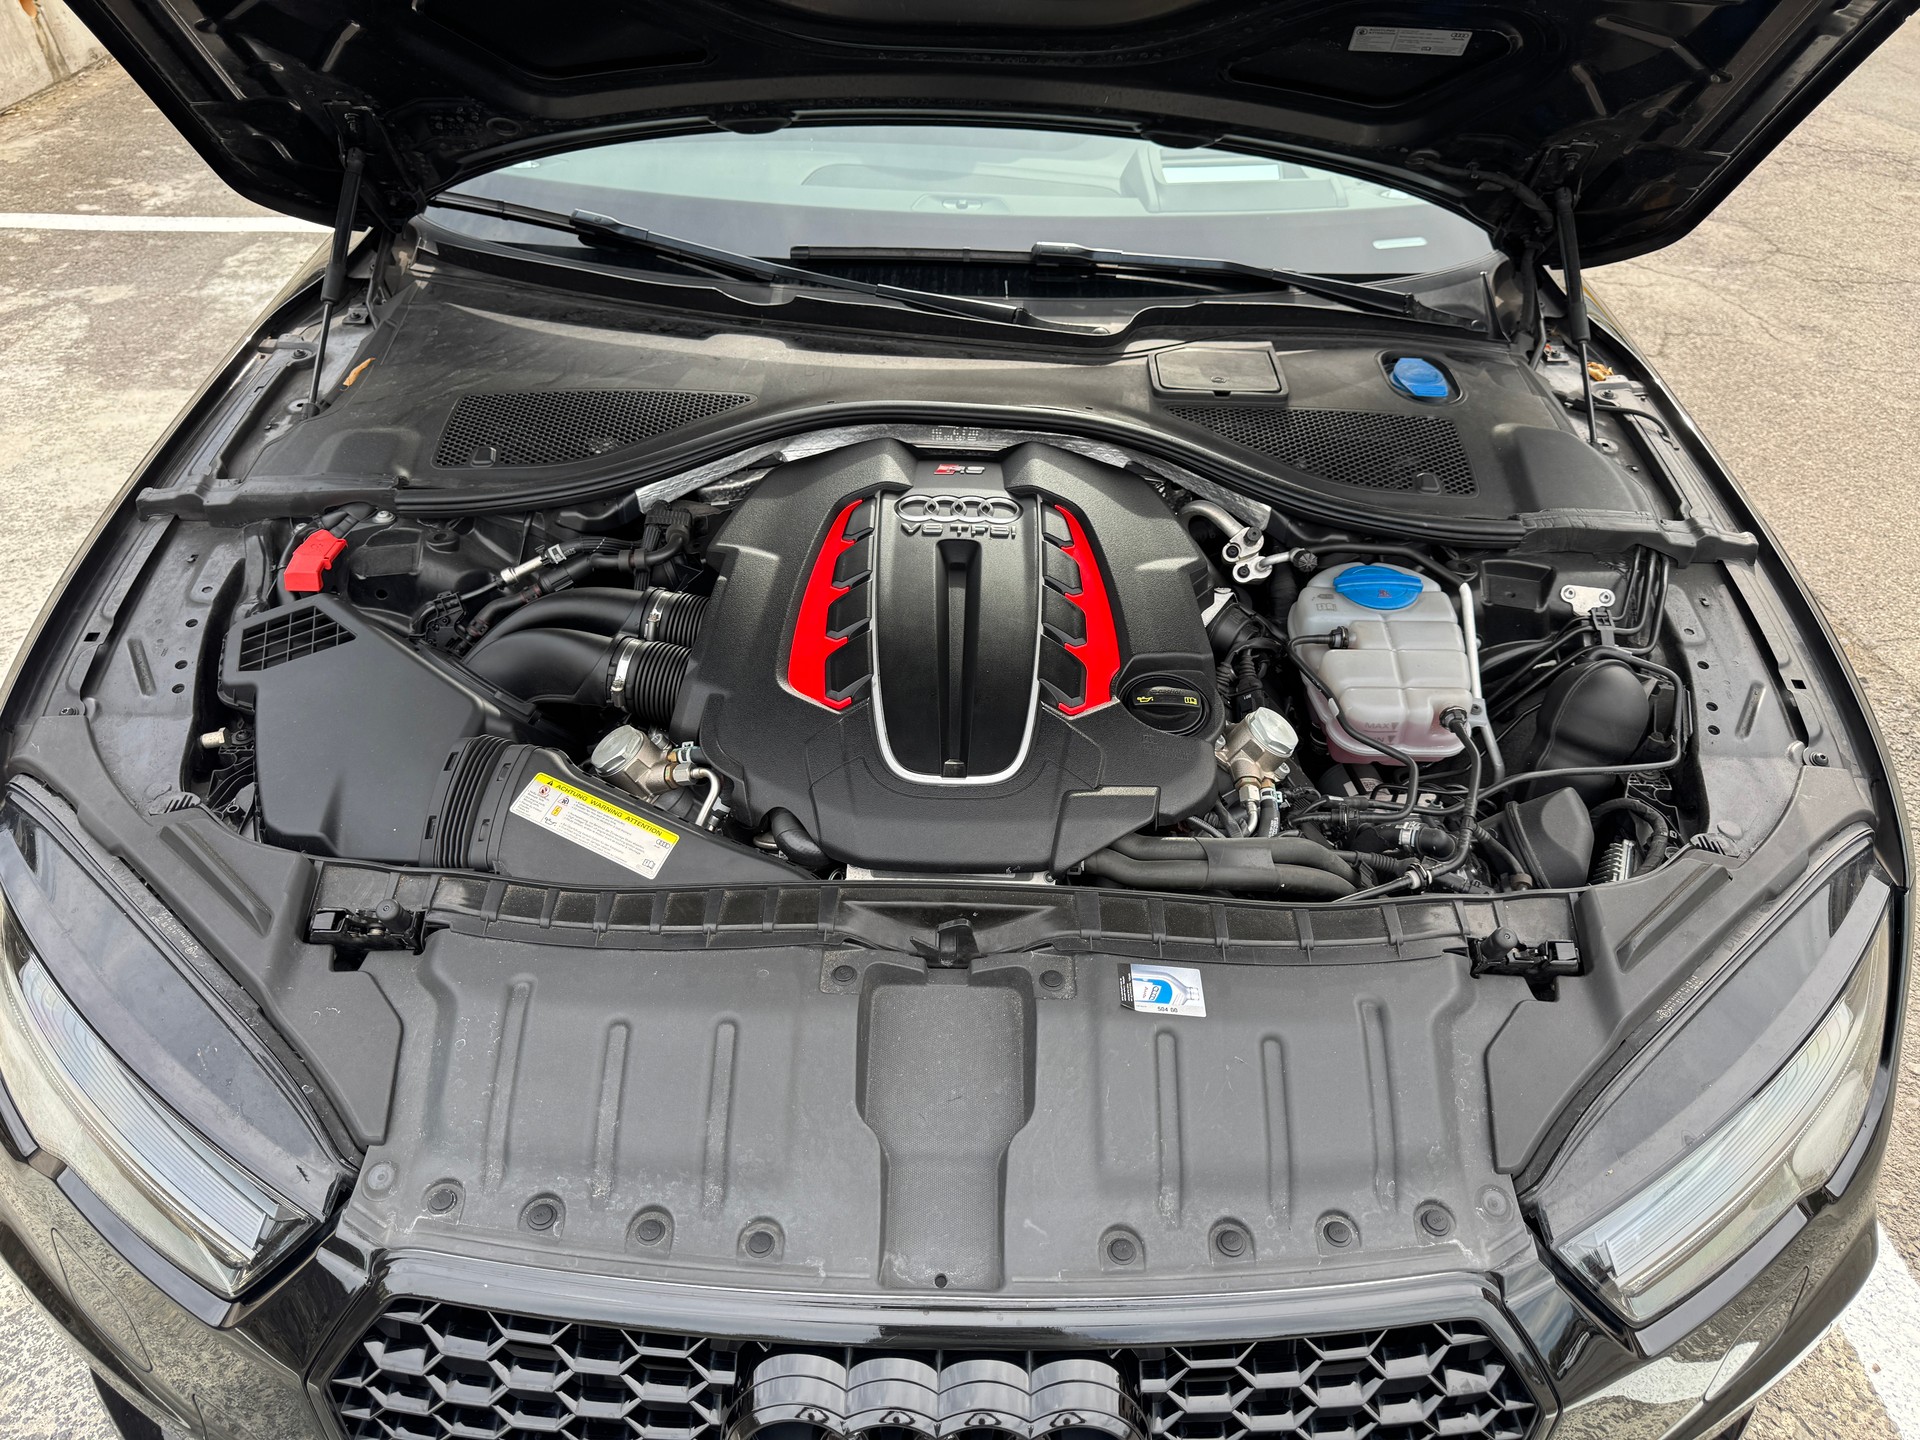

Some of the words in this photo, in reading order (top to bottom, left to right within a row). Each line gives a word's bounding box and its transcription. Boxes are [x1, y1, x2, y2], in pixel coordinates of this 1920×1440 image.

[936, 464, 985, 475] RS
[556, 784, 588, 802] ACHTUNG
[590, 799, 623, 818] WARNING
[625, 816, 663, 837] ATTENTION
